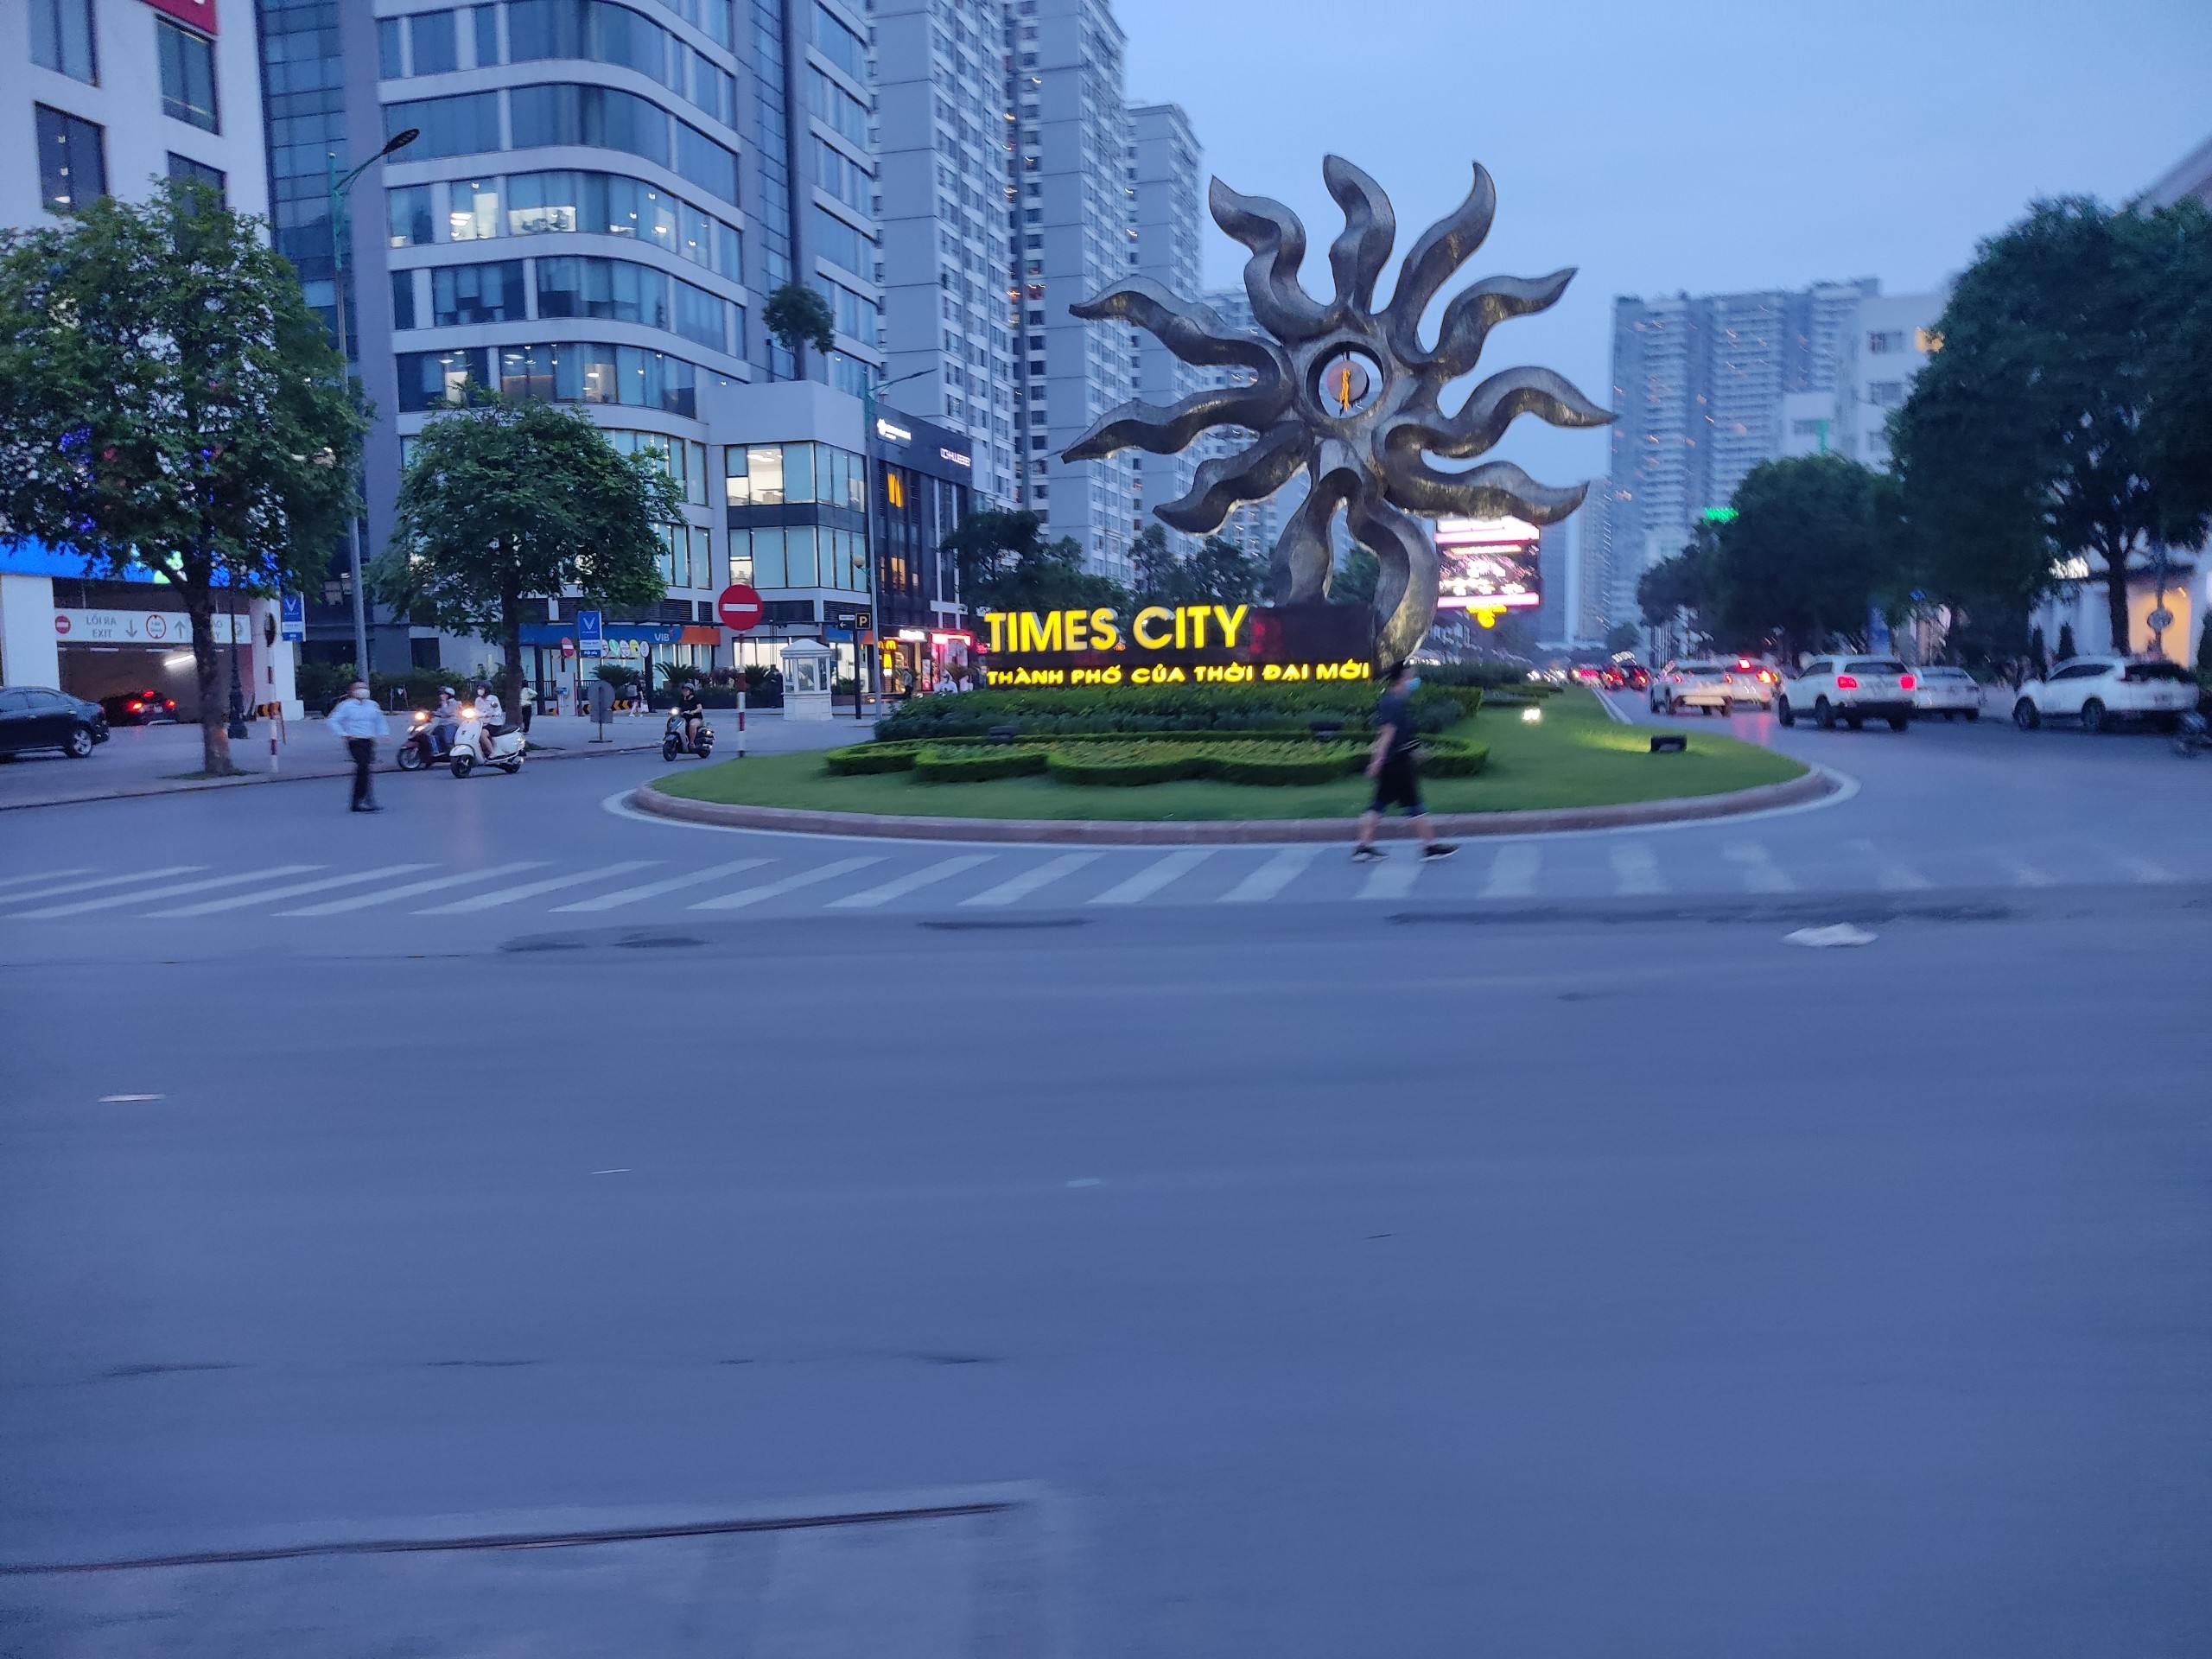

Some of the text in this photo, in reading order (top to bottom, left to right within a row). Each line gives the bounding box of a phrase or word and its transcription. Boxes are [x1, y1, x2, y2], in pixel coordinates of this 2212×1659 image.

[859, 615, 868, 627] P
[92, 628, 113, 639] EXIT
[983, 604, 1249, 653] TIMES CITY
[654, 632, 670, 642] VIB
[986, 667, 1064, 686] THÀNH
[1071, 664, 1122, 684] PHỐ
[1130, 663, 1185, 683] CỦA
[1262, 663, 1308, 682] ĐẠI
[1316, 658, 1370, 680] MỚI
